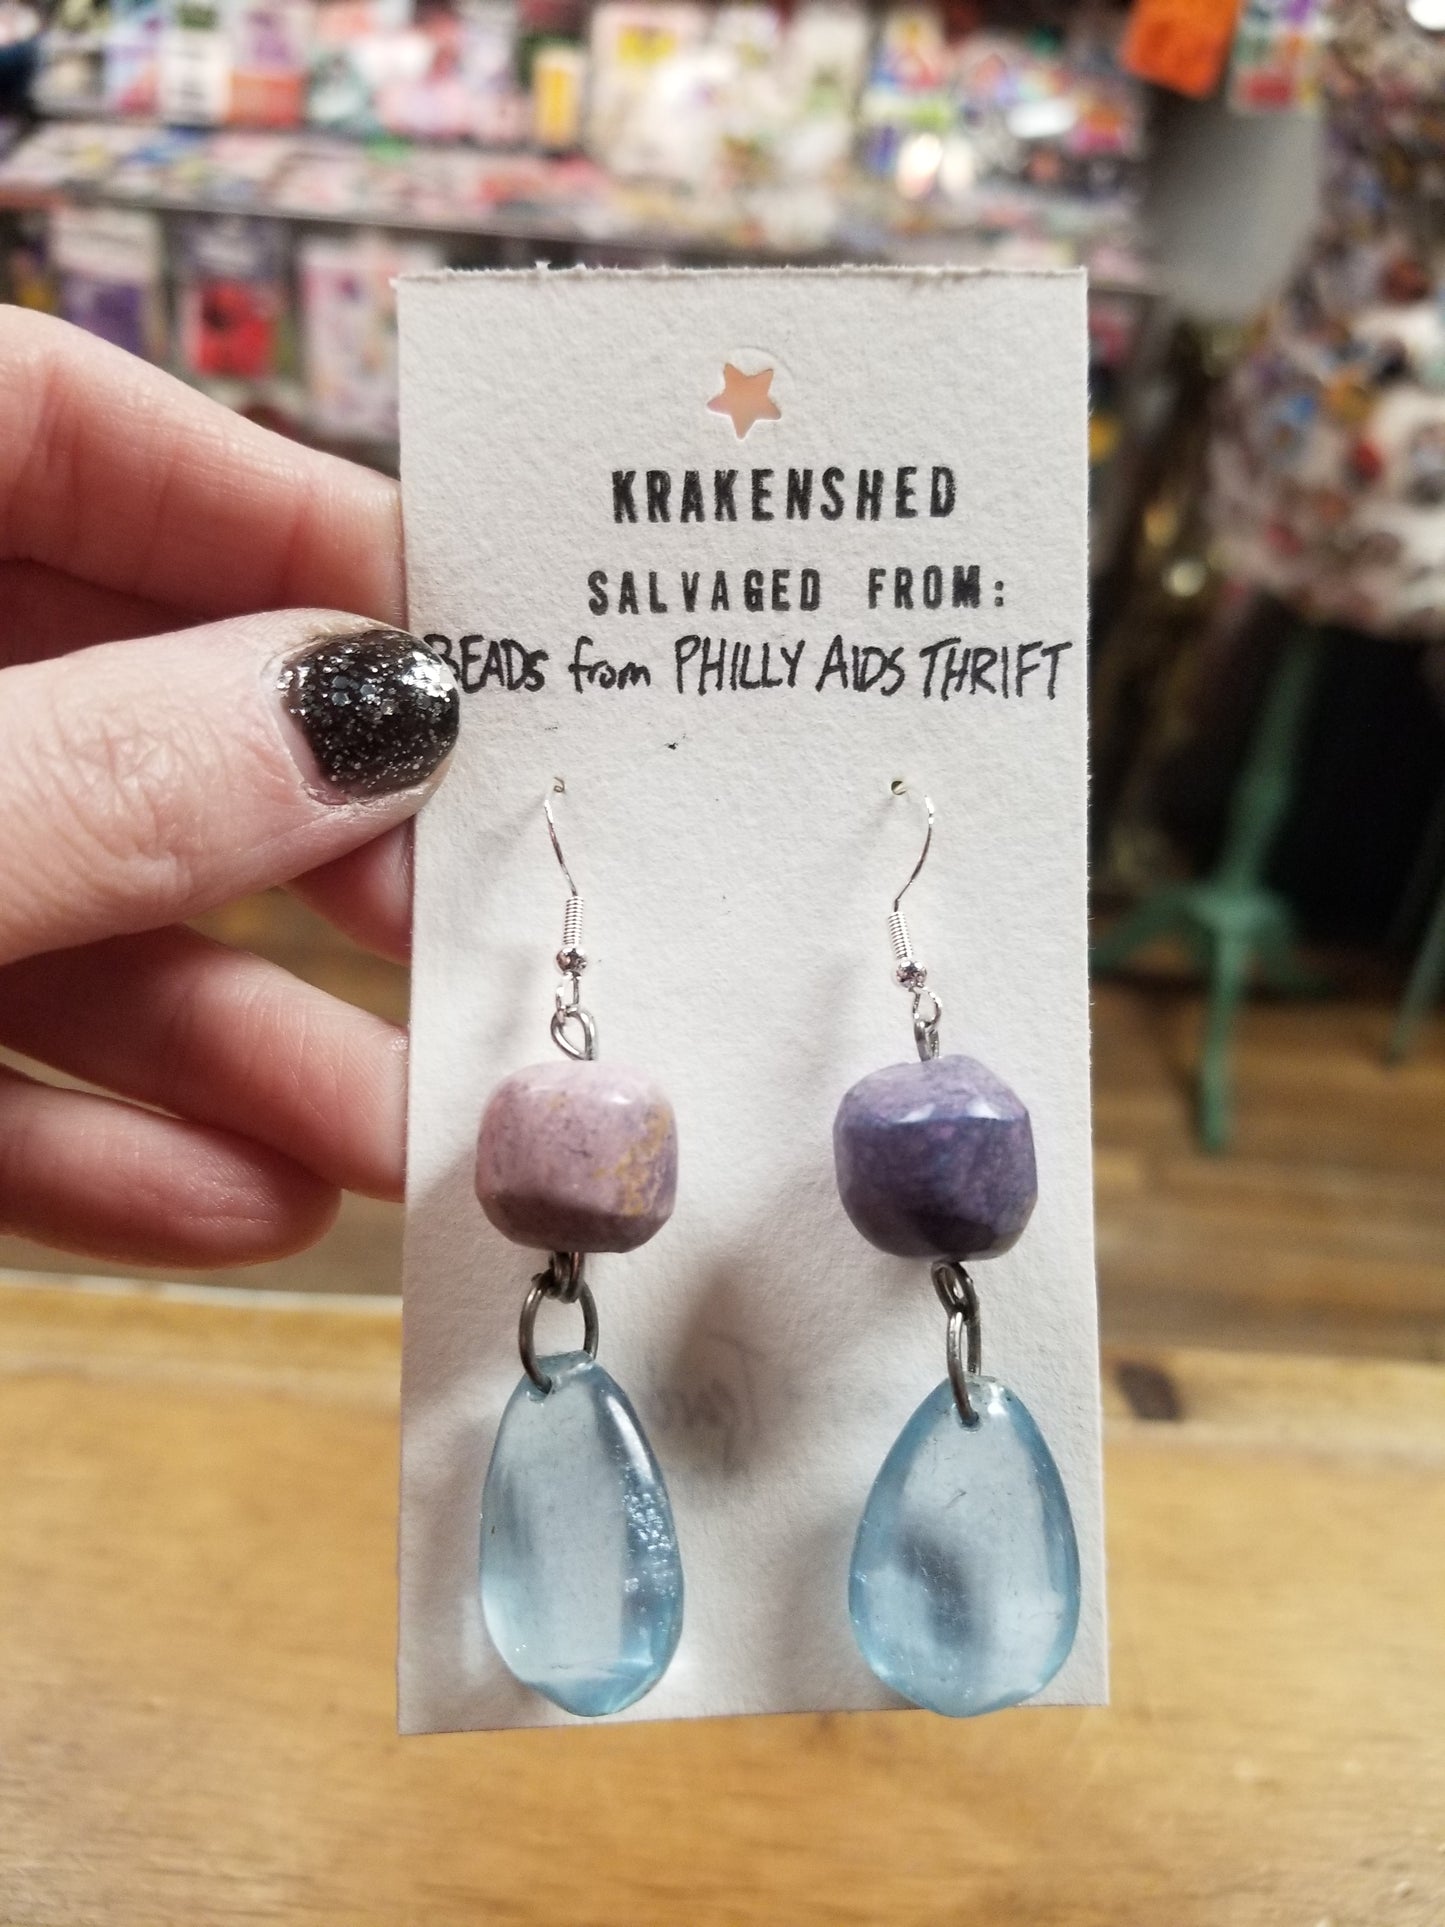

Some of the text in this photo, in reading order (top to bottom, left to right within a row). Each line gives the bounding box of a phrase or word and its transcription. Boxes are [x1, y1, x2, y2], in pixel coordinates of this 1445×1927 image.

[611, 465, 957, 524] KRAKENSHED
[587, 563, 1005, 616] SALVAGED FROM:
[568, 636, 651, 693] from
[674, 634, 806, 695] PHILLY
[815, 636, 905, 696] AIDS
[919, 637, 1073, 701] THRIFT
